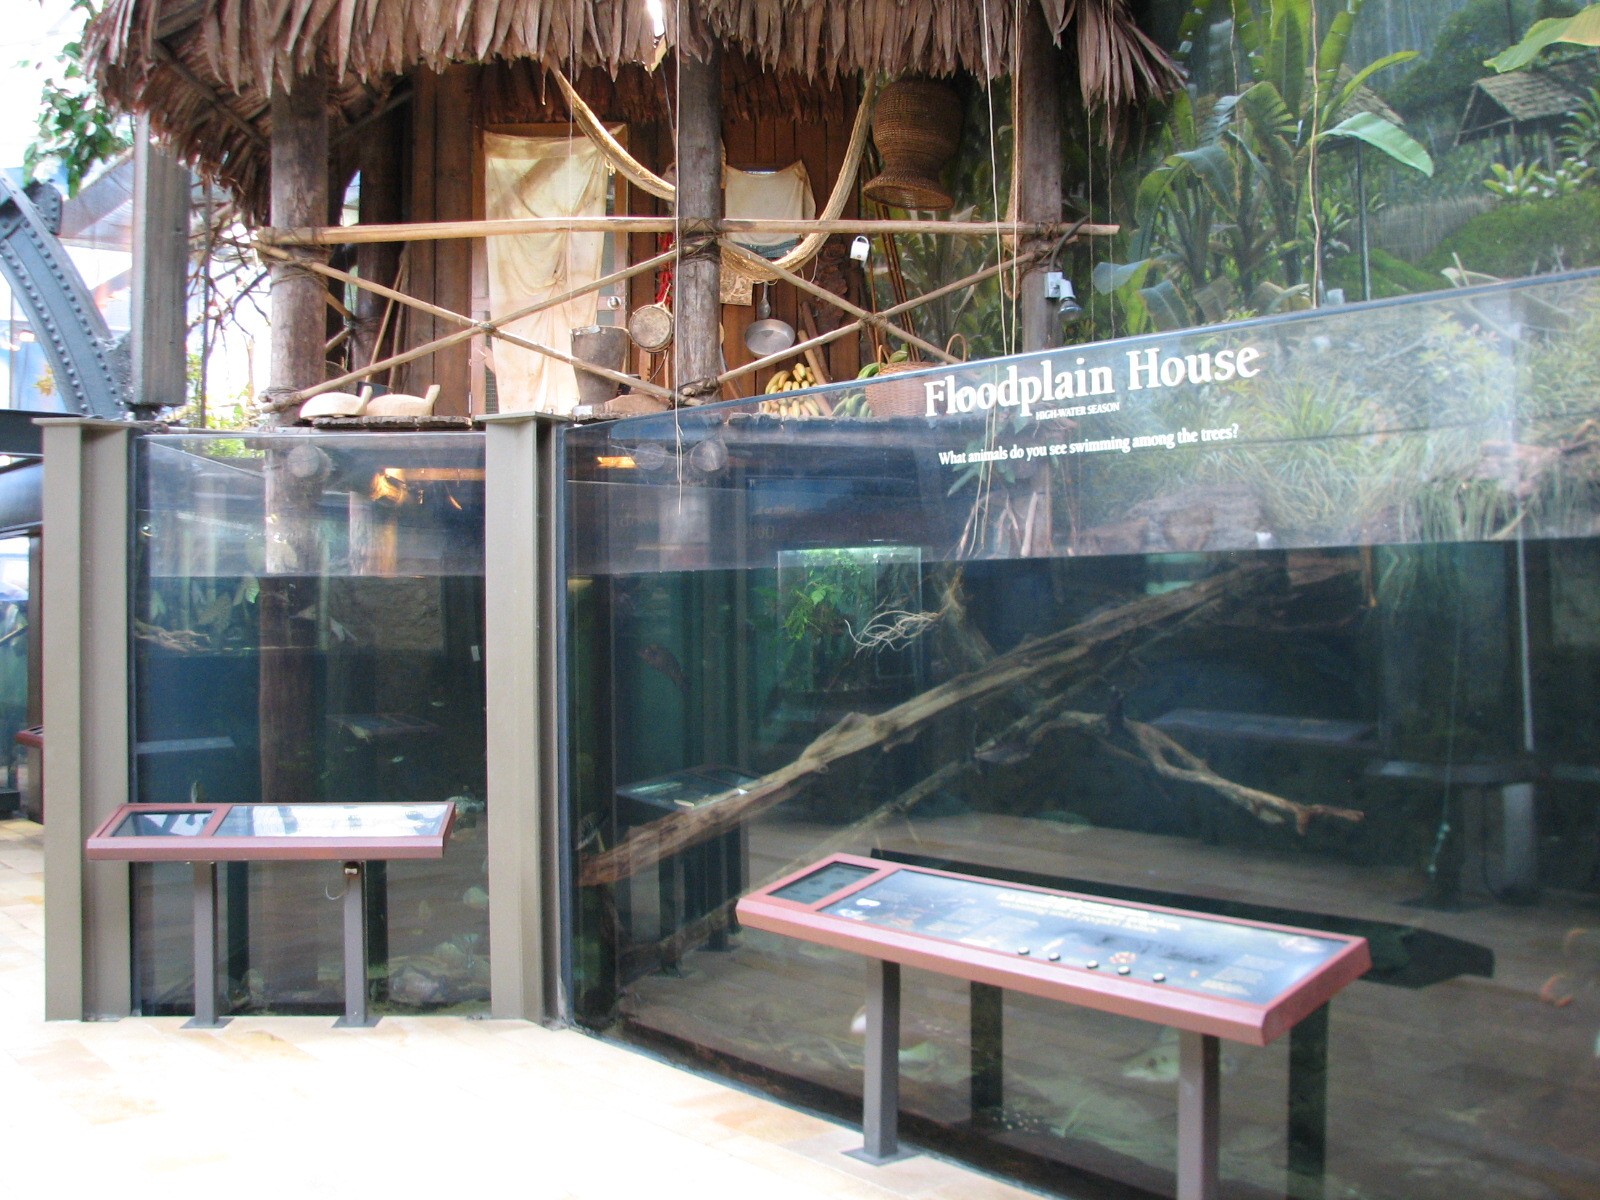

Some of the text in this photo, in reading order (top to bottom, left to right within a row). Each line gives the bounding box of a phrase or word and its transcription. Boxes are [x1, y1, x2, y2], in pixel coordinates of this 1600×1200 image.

[924, 346, 1261, 418] Floodplain House
[1036, 402, 1120, 420] HIGH-WATER SEASON
[939, 422, 1240, 466] What animals do you see swimming among the trees?
